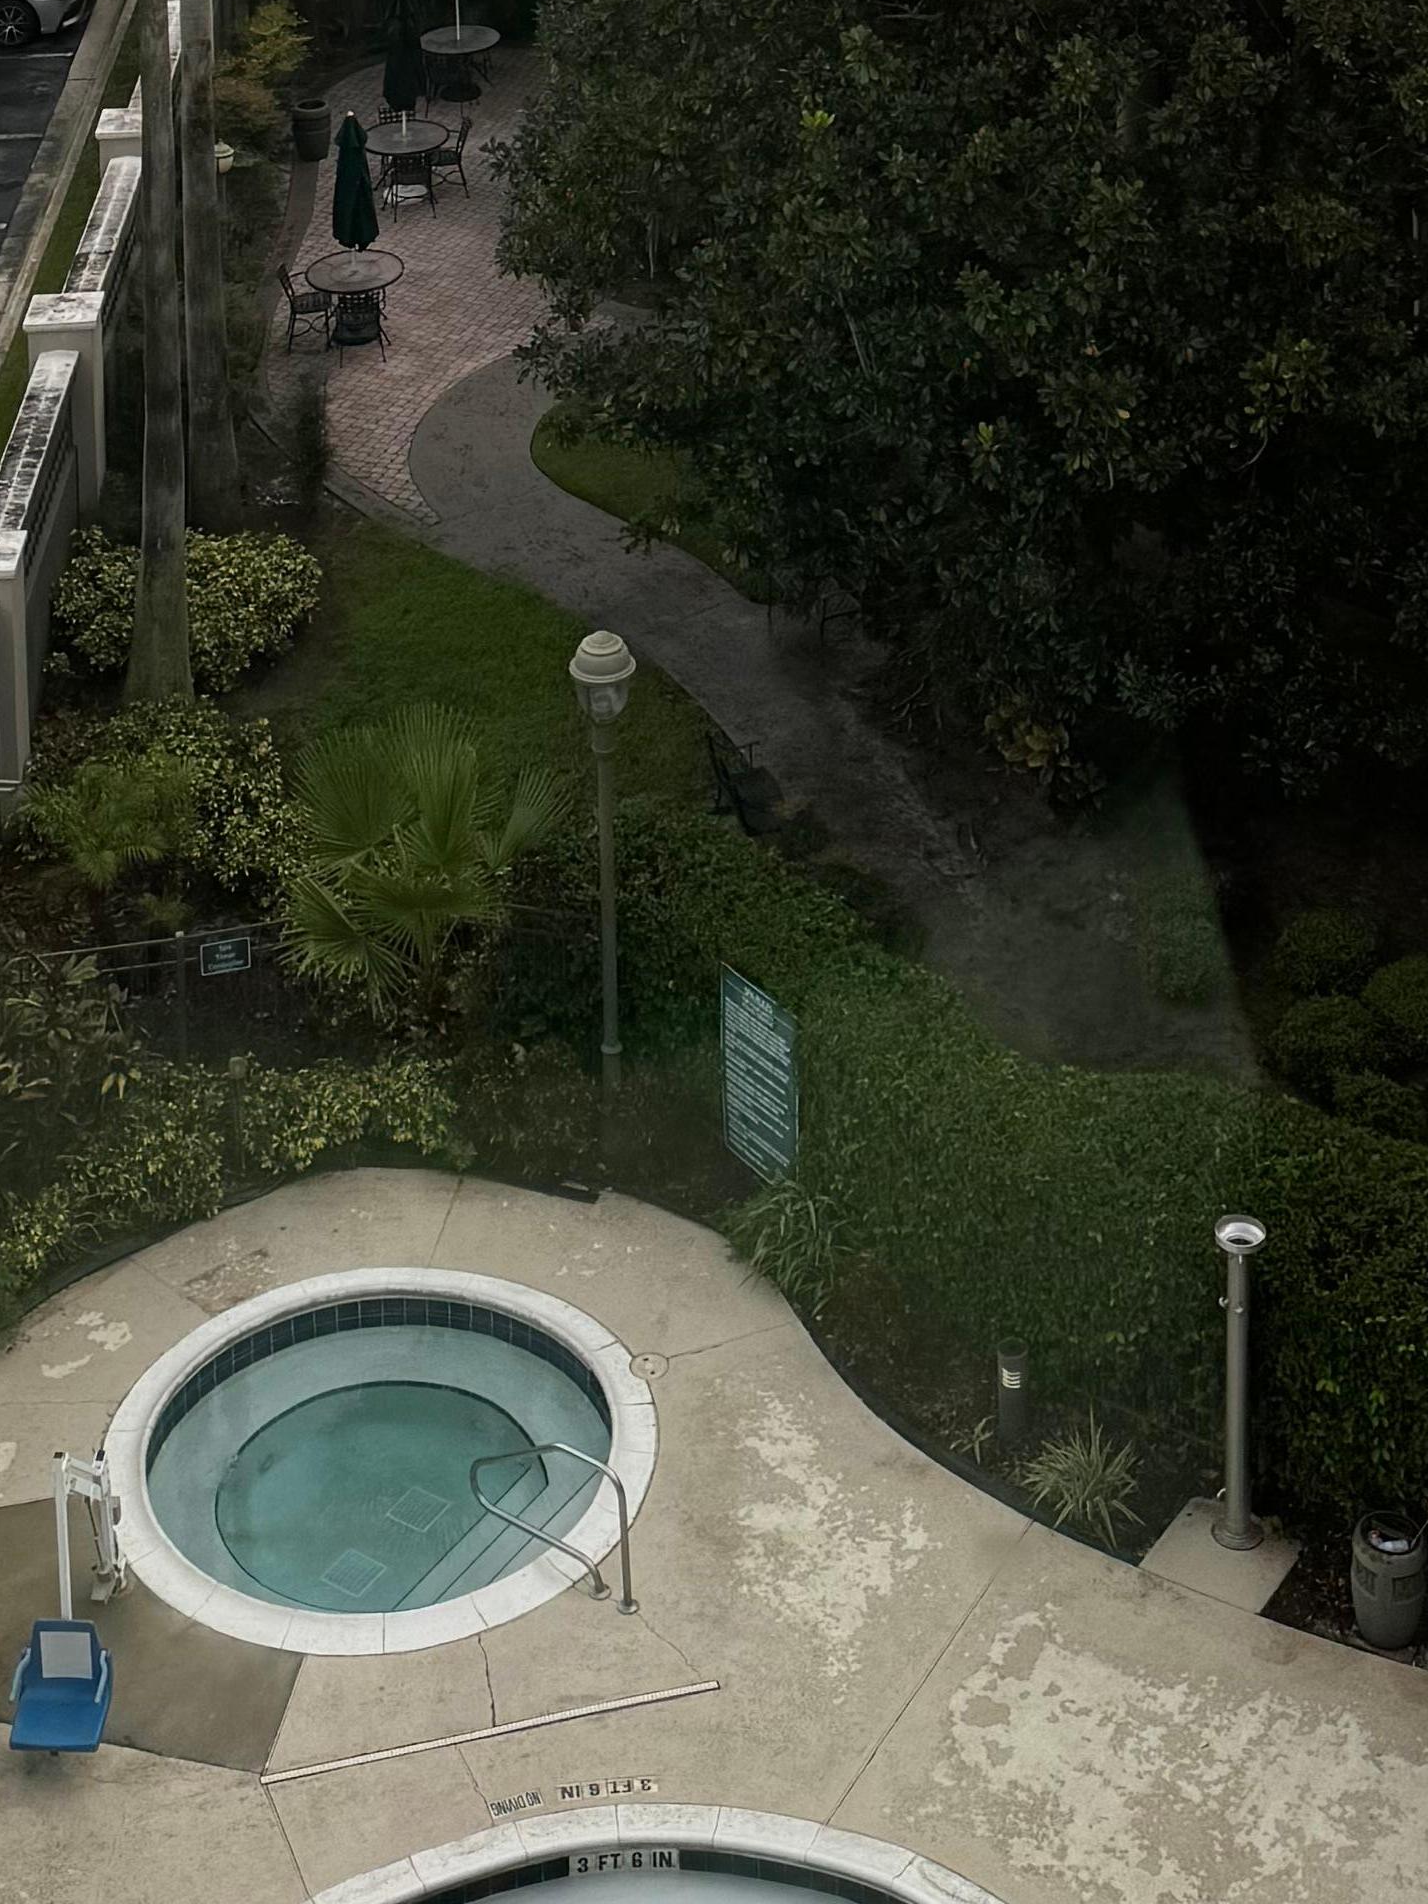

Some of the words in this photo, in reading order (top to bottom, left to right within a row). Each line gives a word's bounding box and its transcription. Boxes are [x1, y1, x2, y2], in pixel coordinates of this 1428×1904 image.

[588, 1782, 600, 1796] 6
[640, 1778, 652, 1791] 3
[490, 1794, 527, 1816] DIVING
[525, 1791, 541, 1807] NO
[577, 1857, 588, 1873] 3
[631, 1851, 642, 1868] 6
